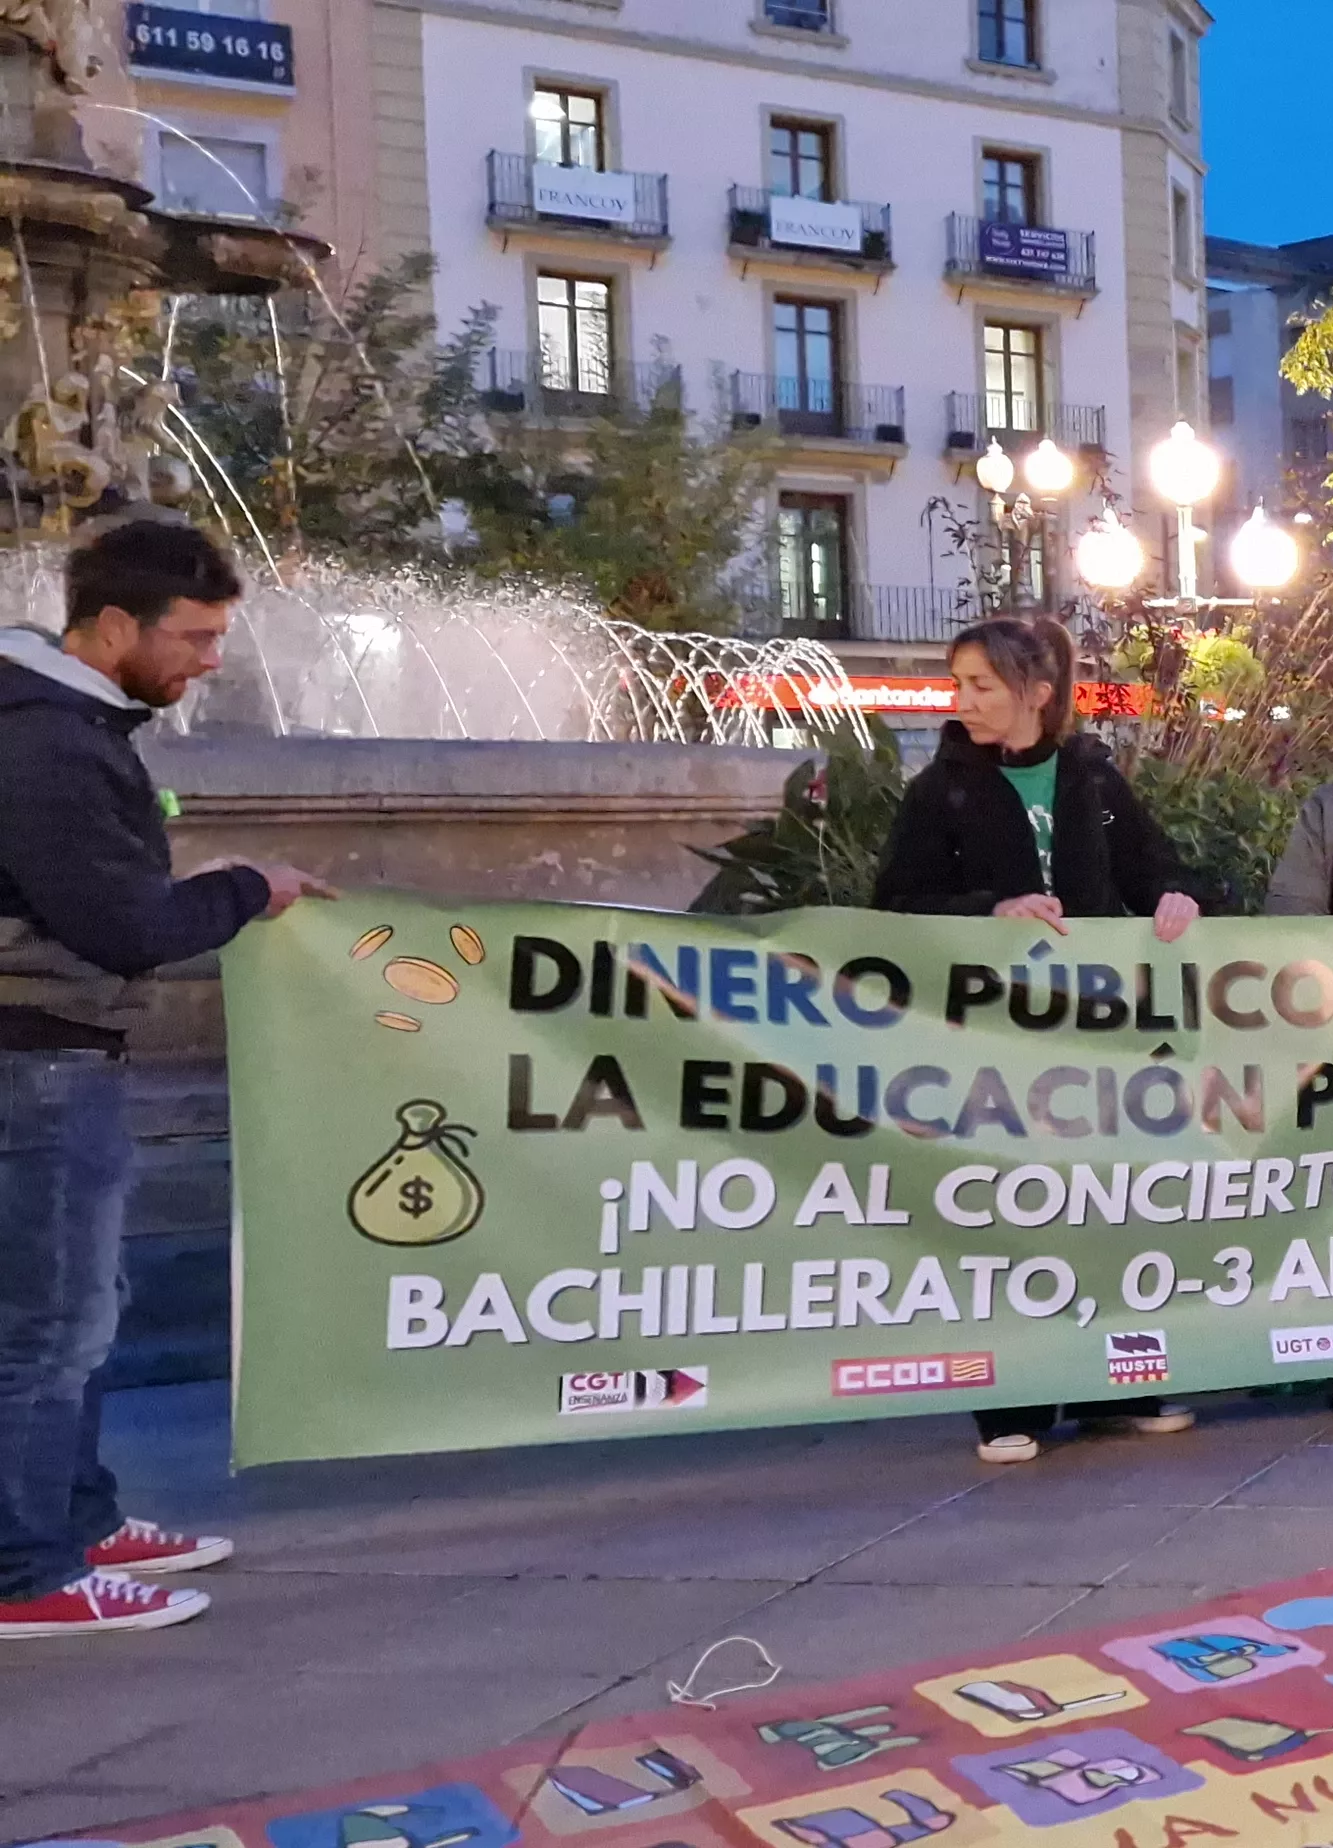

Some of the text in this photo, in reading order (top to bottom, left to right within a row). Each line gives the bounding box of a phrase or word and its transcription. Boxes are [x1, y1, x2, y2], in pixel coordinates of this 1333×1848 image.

[136, 24, 177, 47] 611
[222, 36, 249, 57] 16
[257, 41, 284, 61] 16
[509, 935, 912, 1029] DINERO
[507, 1054, 644, 1133] LA
[679, 1041, 1266, 1139] EDUCACIÓN
[600, 1158, 776, 1254] ¡NO
[794, 1163, 911, 1226] AL
[387, 1255, 1098, 1350] BACHILLERATO,
[1121, 1246, 1253, 1313] 0-3
[1276, 1338, 1313, 1354] UGT
[570, 1371, 624, 1391] CGT
[839, 1361, 945, 1389] CCOO
[1109, 1358, 1167, 1374] HUSTE
